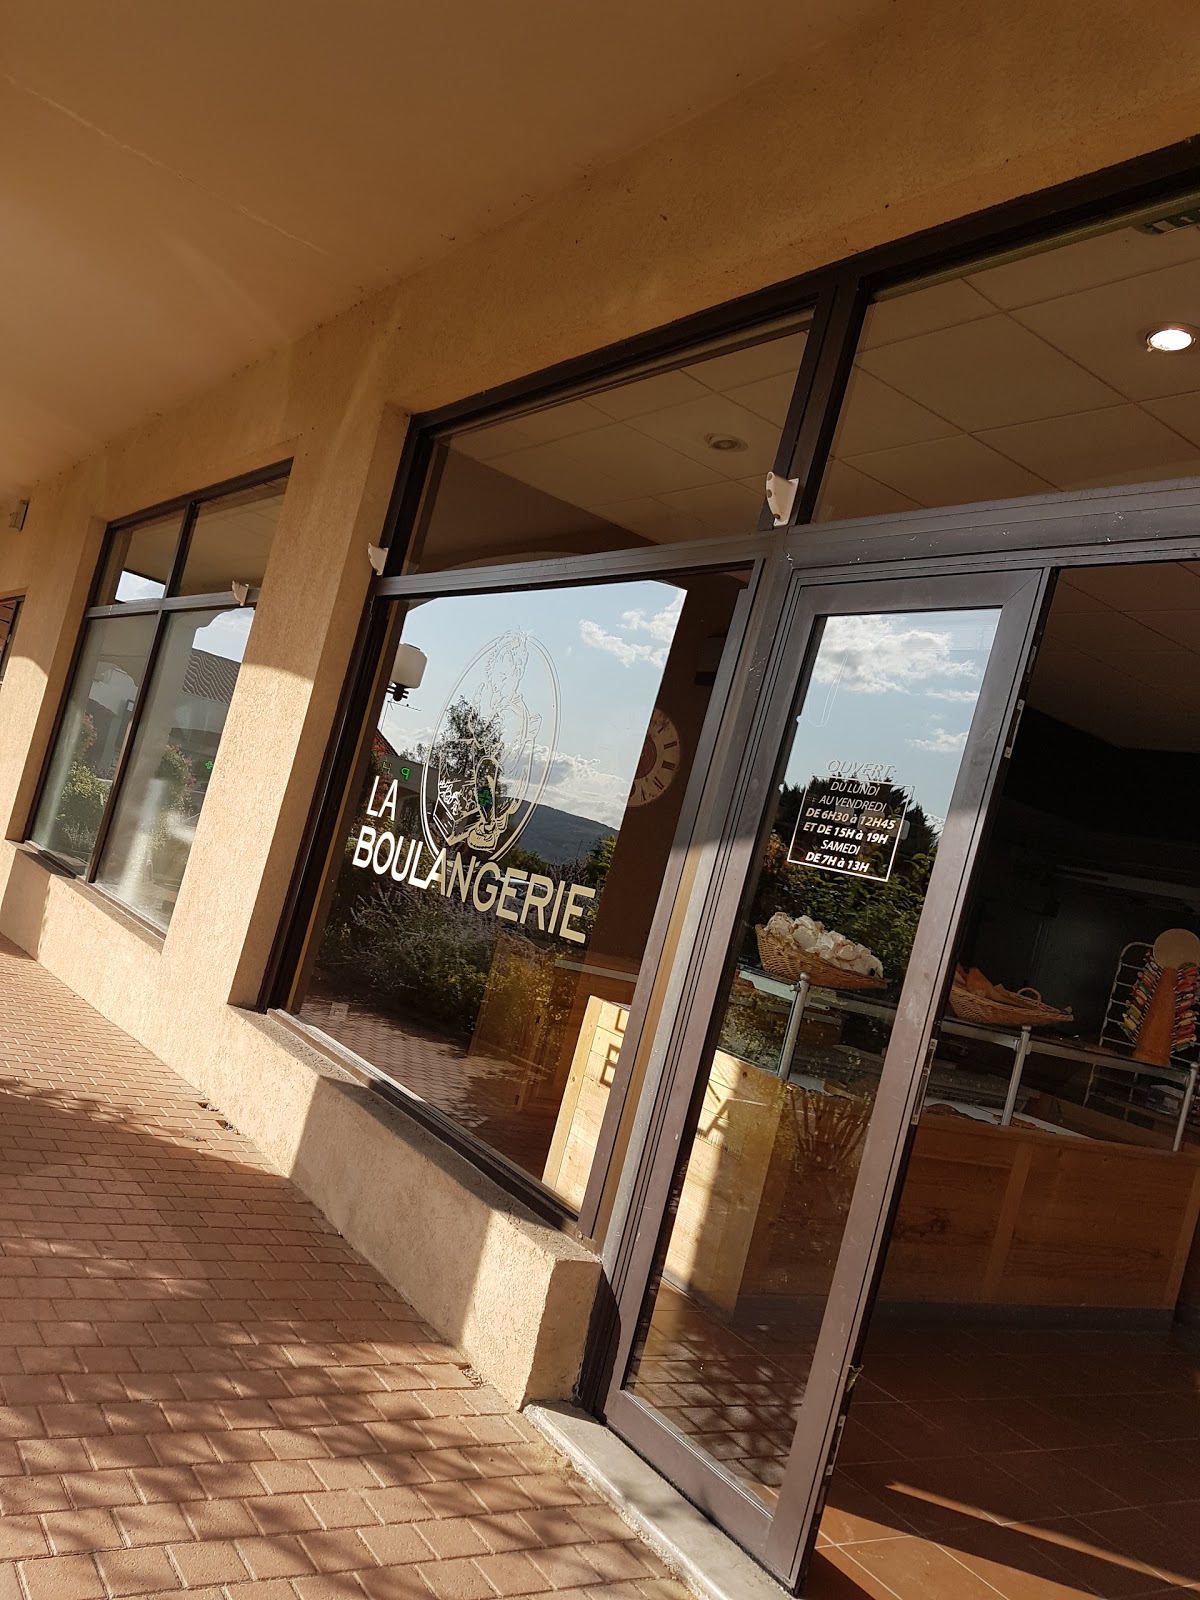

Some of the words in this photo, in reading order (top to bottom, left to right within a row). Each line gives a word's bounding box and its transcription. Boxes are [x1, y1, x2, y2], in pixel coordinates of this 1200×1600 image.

[366, 775, 399, 821] LA
[830, 781, 847, 792] DU
[847, 784, 880, 796] LUNDI
[819, 795, 835, 805] AU
[835, 798, 887, 812] VENDREDI
[806, 808, 821, 818] DE
[821, 810, 849, 822] 6H30
[850, 814, 858, 824] à
[860, 816, 896, 830] 12H45
[803, 822, 817, 832] ET
[817, 824, 832, 835] DE
[834, 827, 855, 839] 15H
[855, 830, 863, 840] à
[867, 833, 889, 845] 19H
[821, 840, 860, 855] SAMEDI
[805, 852, 820, 862] DE
[821, 854, 838, 867] 7H
[837, 859, 845, 869] à
[847, 860, 870, 873] 13H
[352, 825, 596, 944] BOULANGERIE
